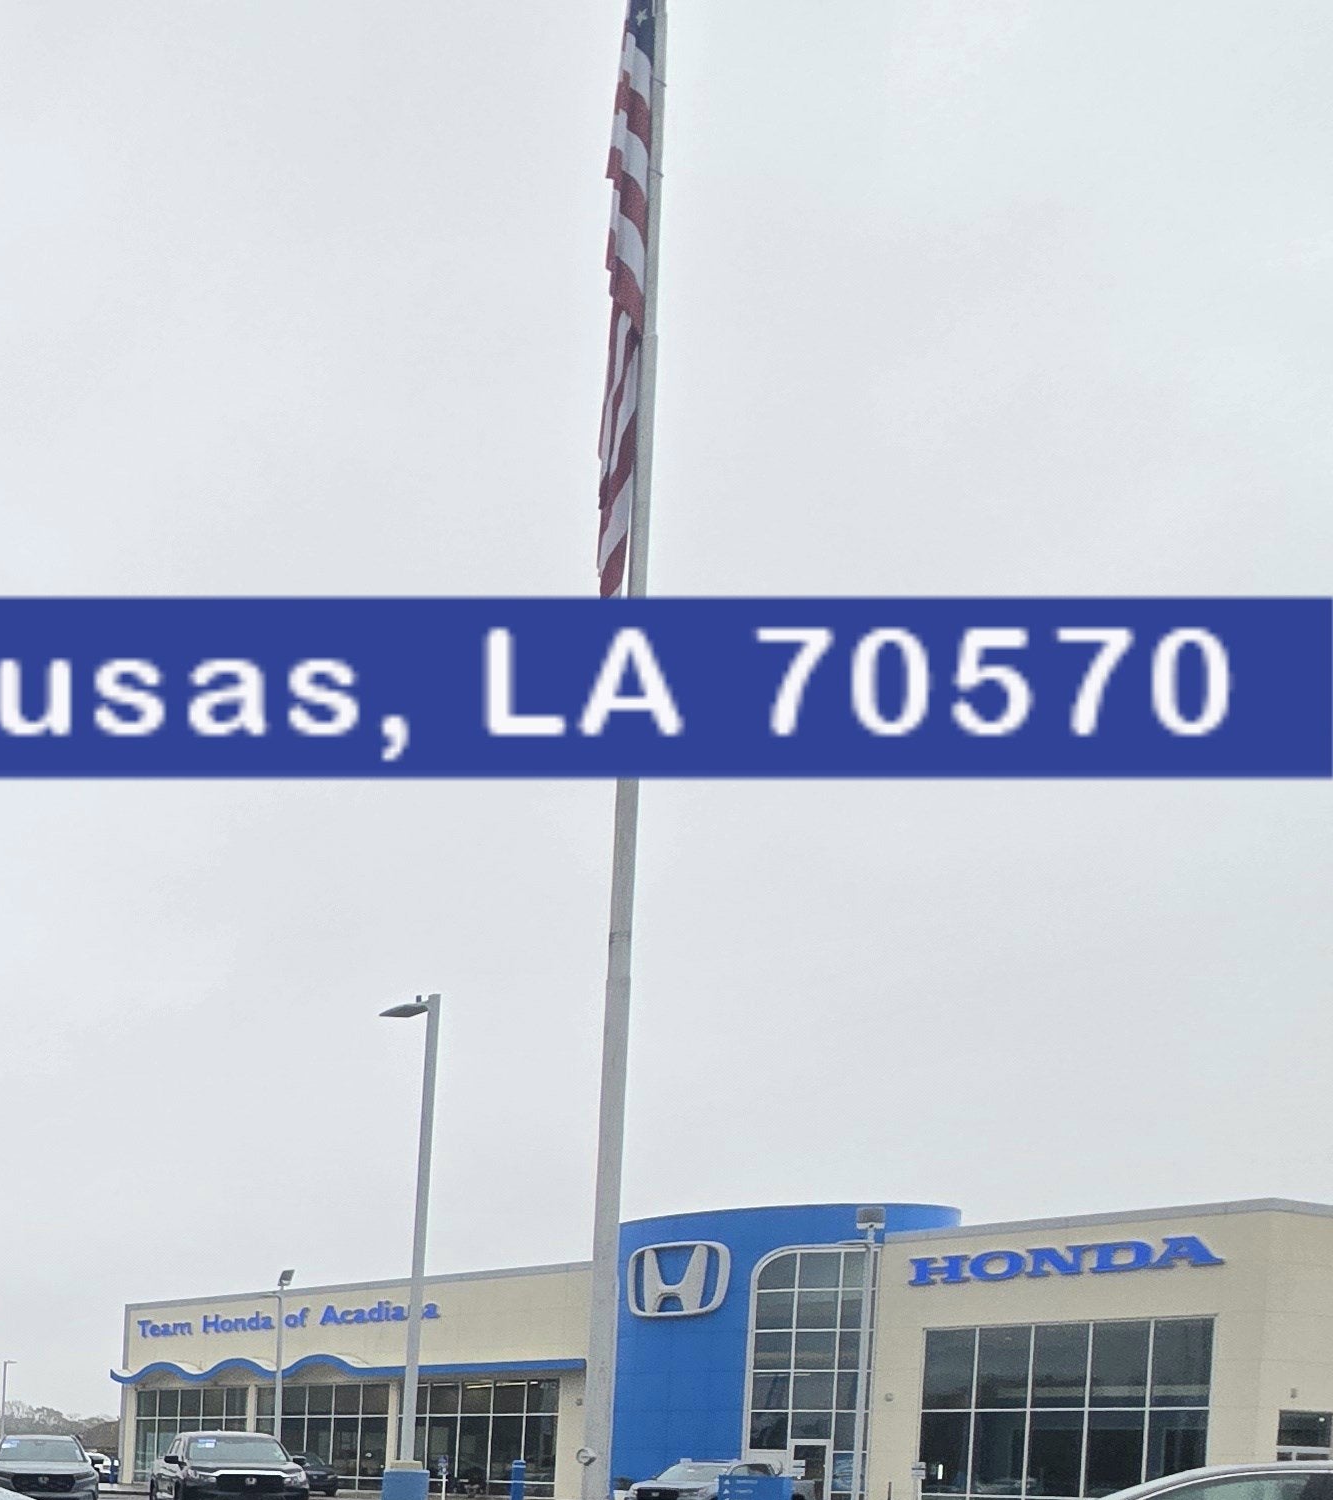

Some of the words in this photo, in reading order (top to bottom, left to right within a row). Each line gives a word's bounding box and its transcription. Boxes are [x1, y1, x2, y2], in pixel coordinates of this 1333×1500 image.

[908, 1235, 1225, 1286] HONDA
[137, 1319, 193, 1338] Team
[202, 1311, 275, 1336] Honda
[284, 1307, 310, 1328] of
[319, 1301, 440, 1326] Acadiaa
